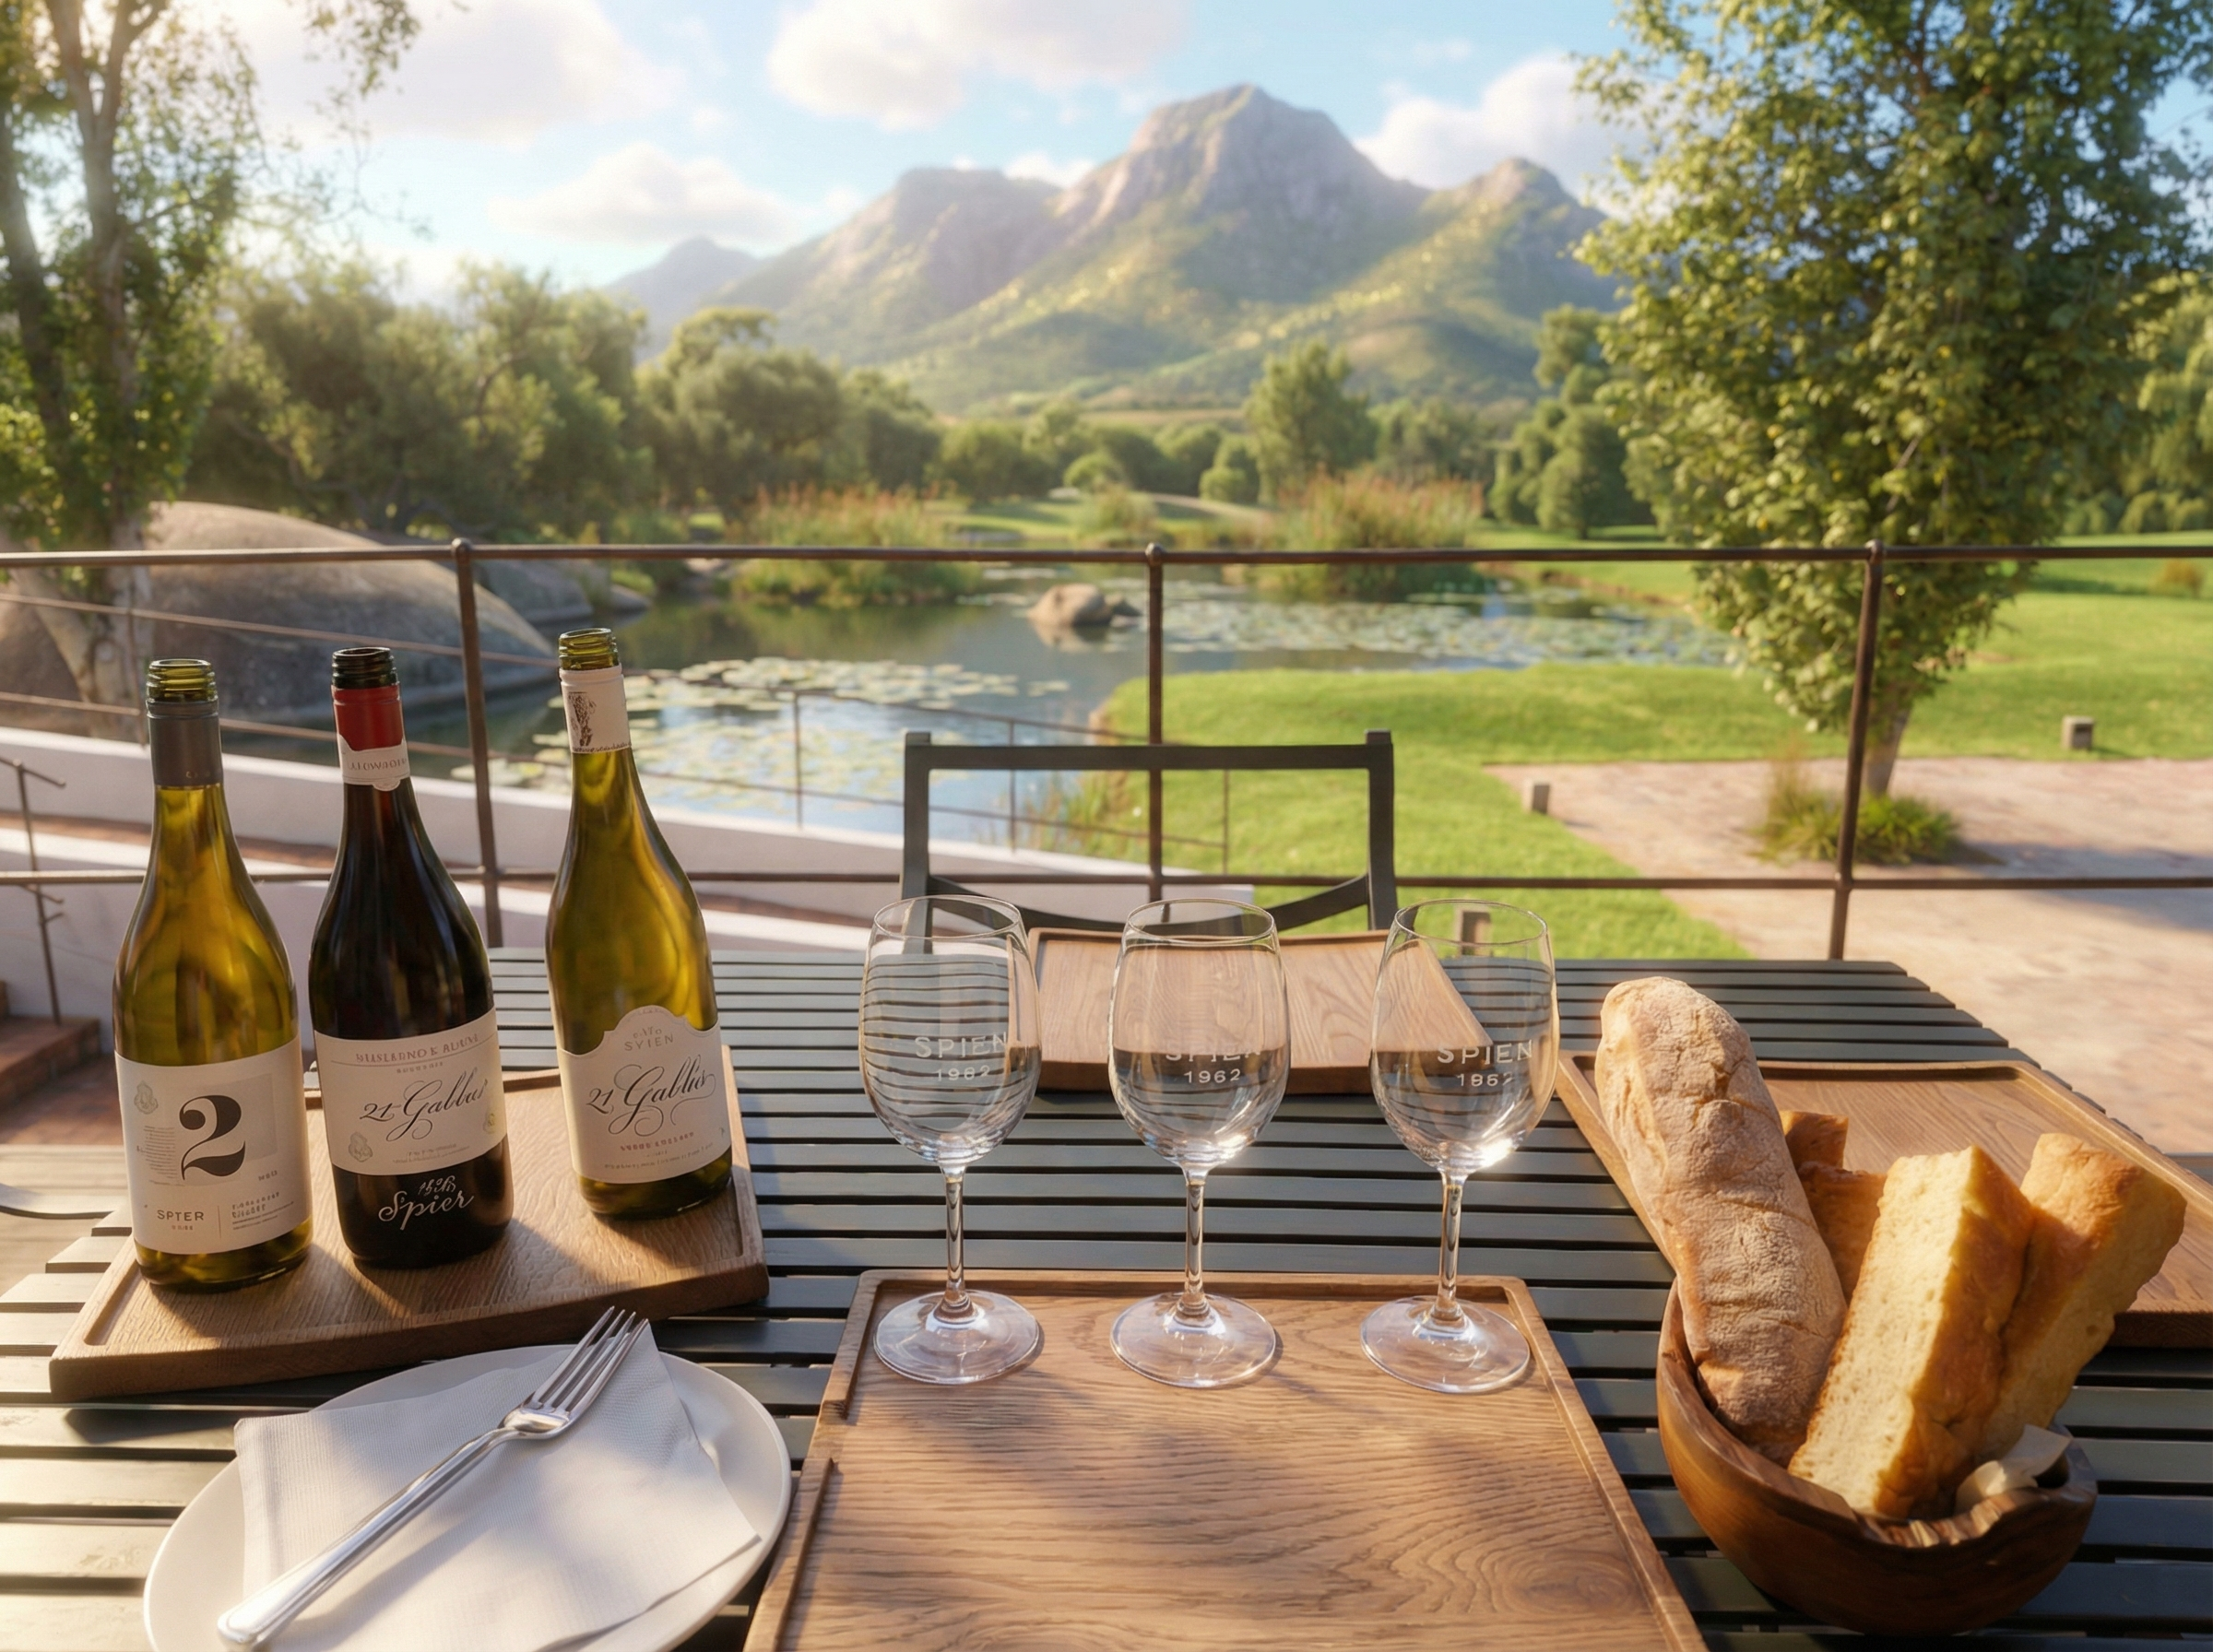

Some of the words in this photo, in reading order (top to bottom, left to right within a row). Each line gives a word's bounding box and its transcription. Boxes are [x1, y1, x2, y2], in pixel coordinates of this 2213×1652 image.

[1183, 1068, 1241, 1083] 1962
[586, 1088, 615, 1115] 21
[179, 1094, 246, 1181] 2
[378, 1190, 475, 1231] Spier
